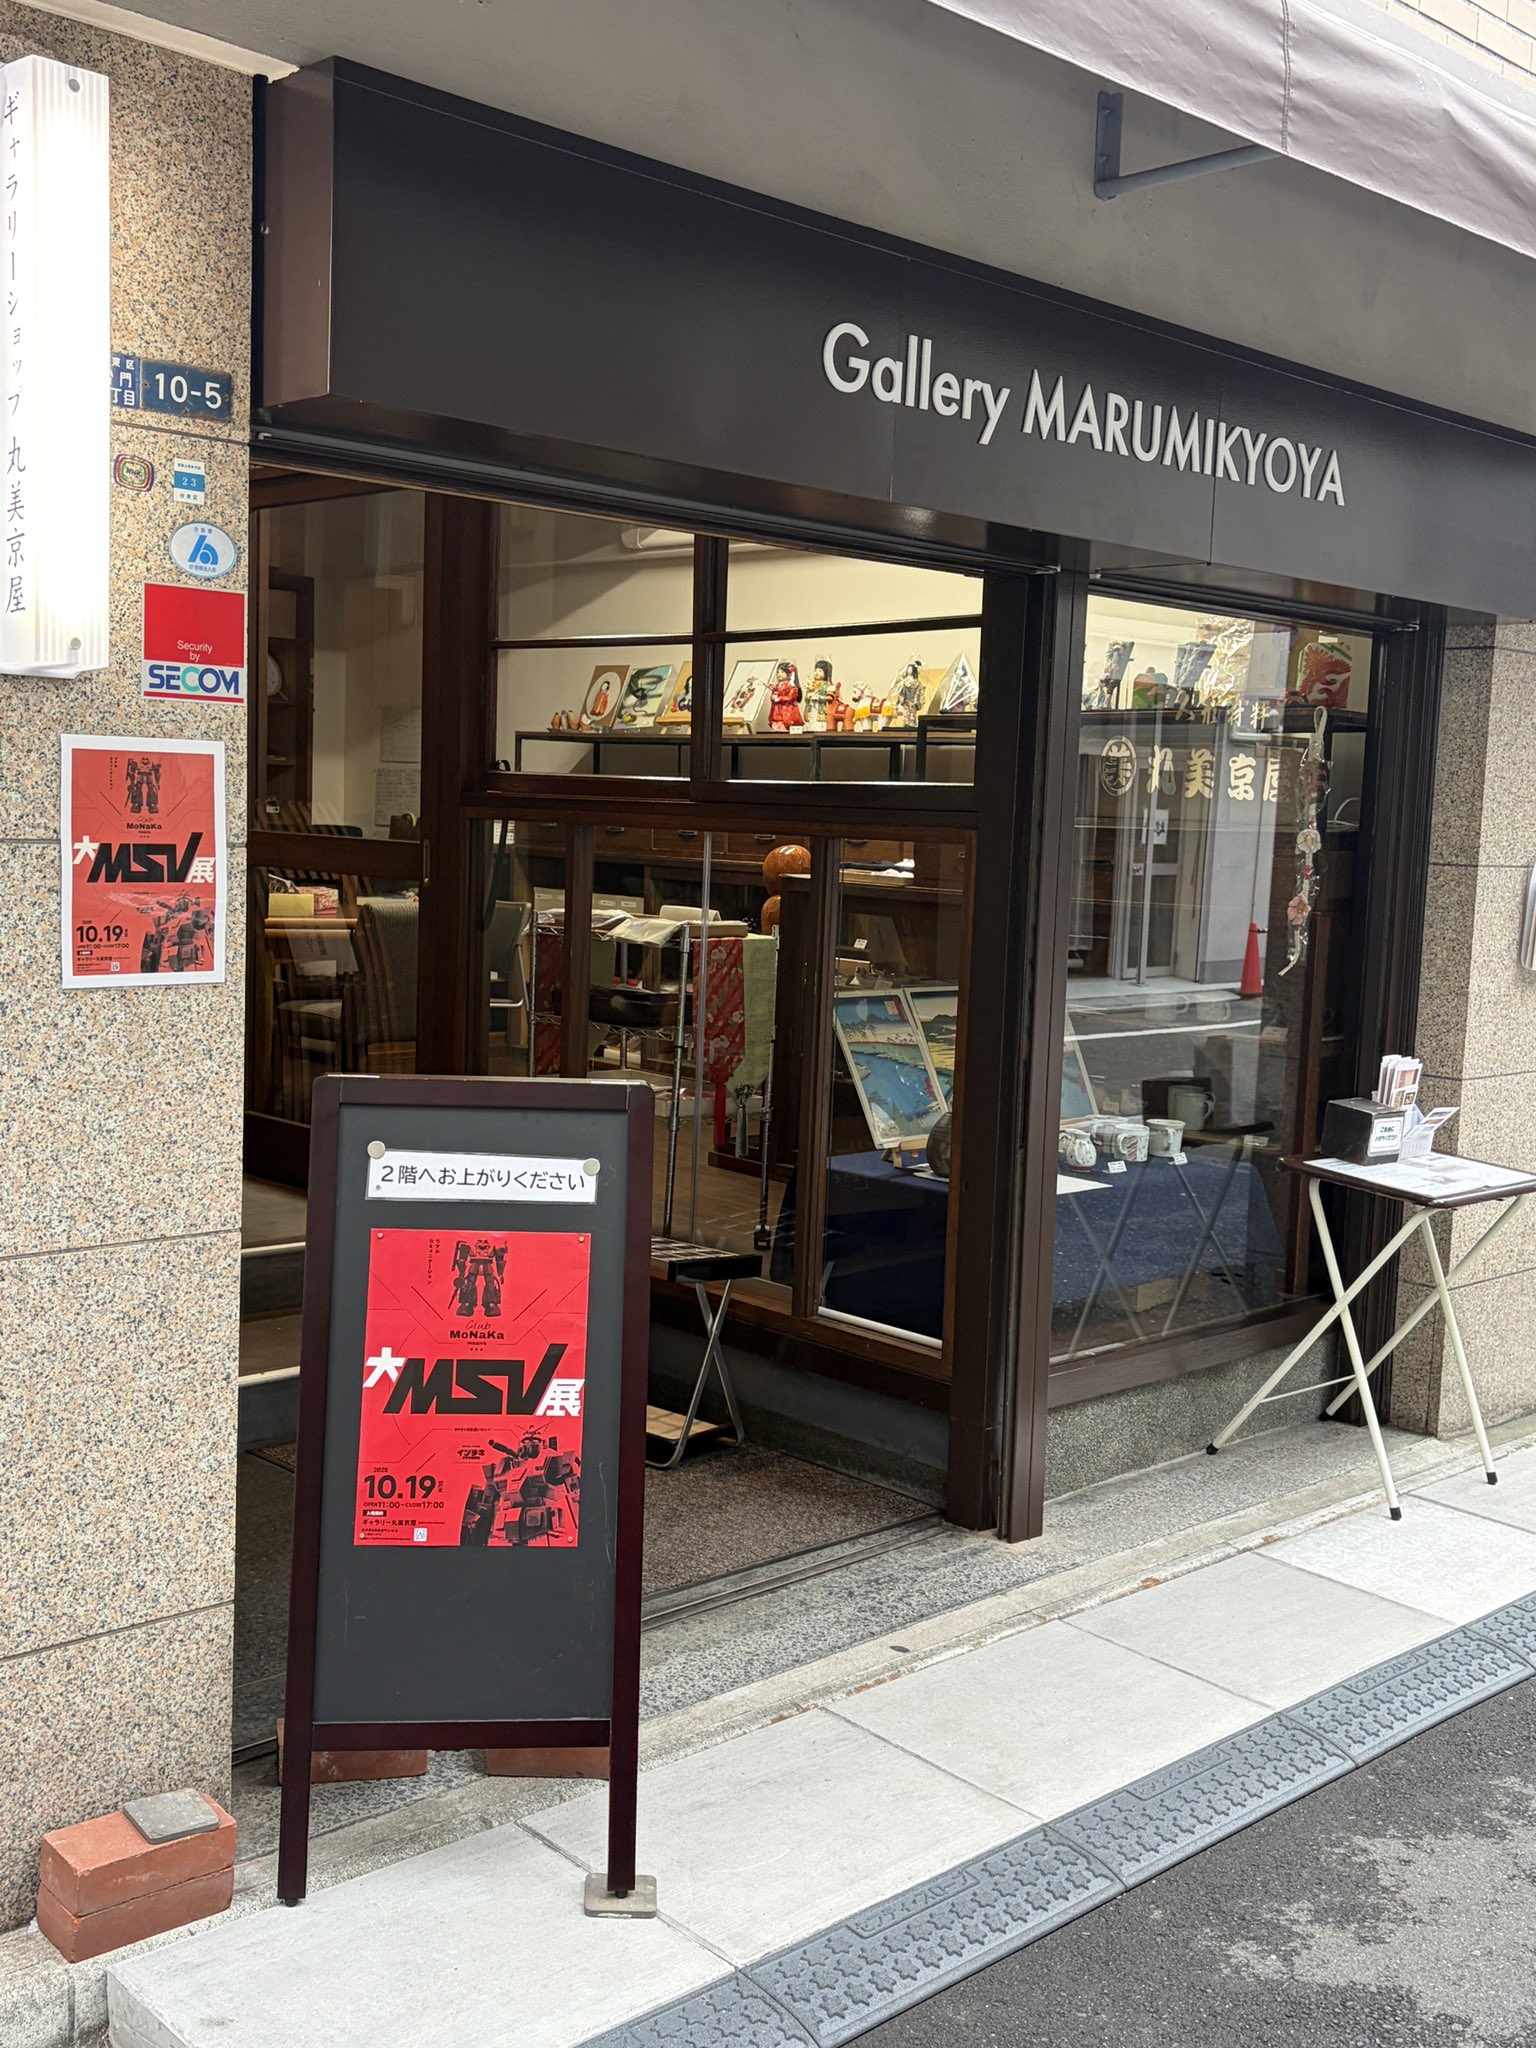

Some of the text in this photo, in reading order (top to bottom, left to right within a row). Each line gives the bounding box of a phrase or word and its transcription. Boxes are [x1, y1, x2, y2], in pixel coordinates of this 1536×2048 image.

[155, 372, 222, 410] 10-5
[823, 322, 1346, 507] Gallery MARUMIKYOYA
[177, 640, 213, 654] Security
[189, 651, 201, 663] by
[148, 664, 240, 695] SECOM
[76, 925, 123, 943] 10.19
[381, 1165, 585, 1191] 2階へお上がりください
[450, 1330, 505, 1340] MoNaKa
[364, 1475, 437, 1499] 10.19
